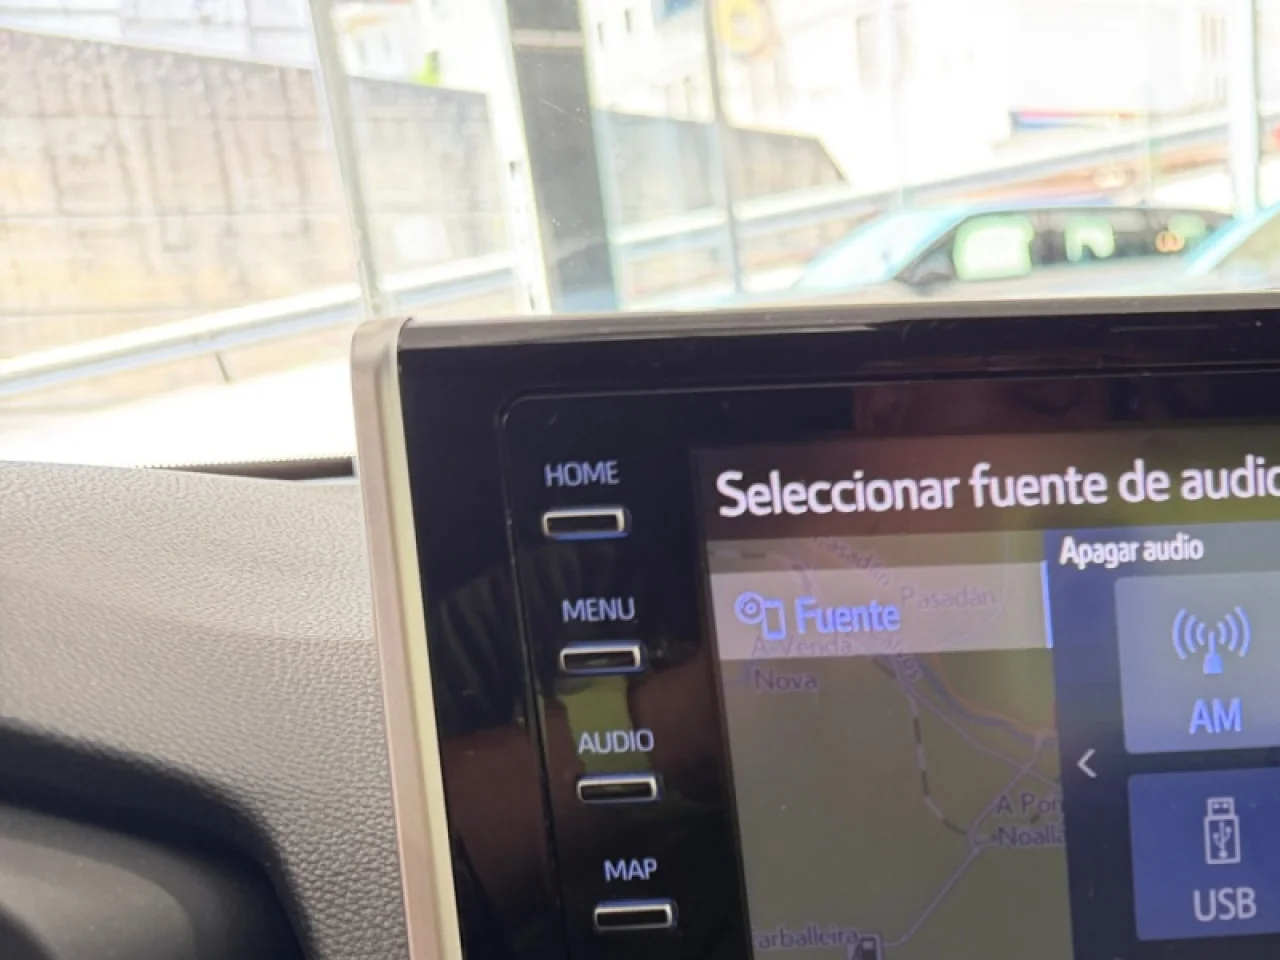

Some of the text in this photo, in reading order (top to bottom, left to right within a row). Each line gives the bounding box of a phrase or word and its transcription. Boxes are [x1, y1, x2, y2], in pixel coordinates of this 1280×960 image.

[545, 461, 620, 488] HOME
[716, 469, 960, 518] Seleccionar
[970, 462, 1109, 508] fuente
[1119, 458, 1171, 502] de
[1060, 532, 1204, 570] Apagar audio
[562, 598, 636, 623] MENU
[795, 597, 900, 635] Fuente
[754, 669, 818, 692] Nova
[1188, 699, 1242, 735] AM
[578, 729, 654, 754] AUDIO
[997, 794, 1014, 815] A
[605, 859, 658, 881] MAP
[1194, 888, 1257, 923] USB
[753, 924, 859, 950] arballeira
